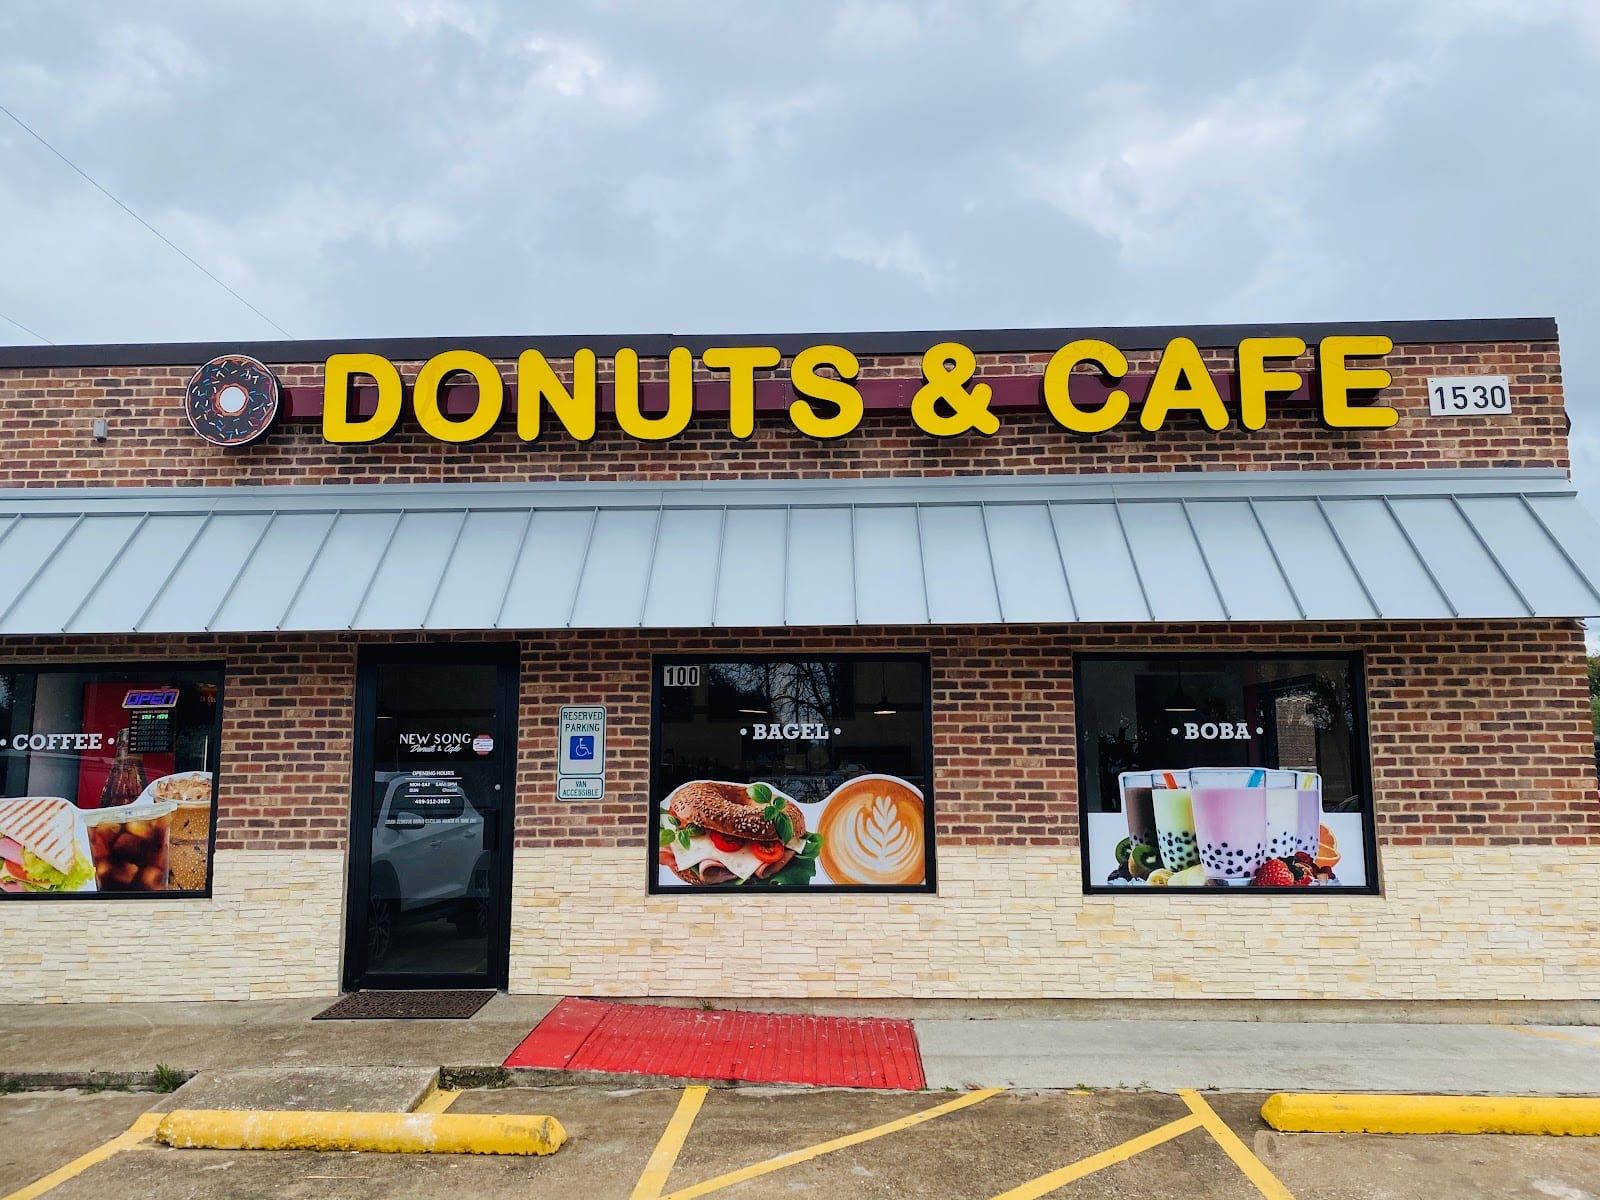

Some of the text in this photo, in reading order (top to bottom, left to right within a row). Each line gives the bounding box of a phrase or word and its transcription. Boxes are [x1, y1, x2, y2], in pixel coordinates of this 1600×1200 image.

[322, 335, 1400, 443] DONUTS & CAFE
[1433, 385, 1507, 410] 1530
[666, 666, 698, 686] 100
[126, 692, 176, 705] OPEN
[563, 711, 603, 721] RESERVED
[565, 723, 600, 732] PARKING
[752, 723, 830, 740] BAGEL
[1183, 722, 1252, 740] BOBA
[12, 733, 103, 751] COFFEE
[399, 732, 471, 745] NEW SONG
[575, 780, 587, 788] VAN
[562, 789, 599, 797] ACCESSIBLE
